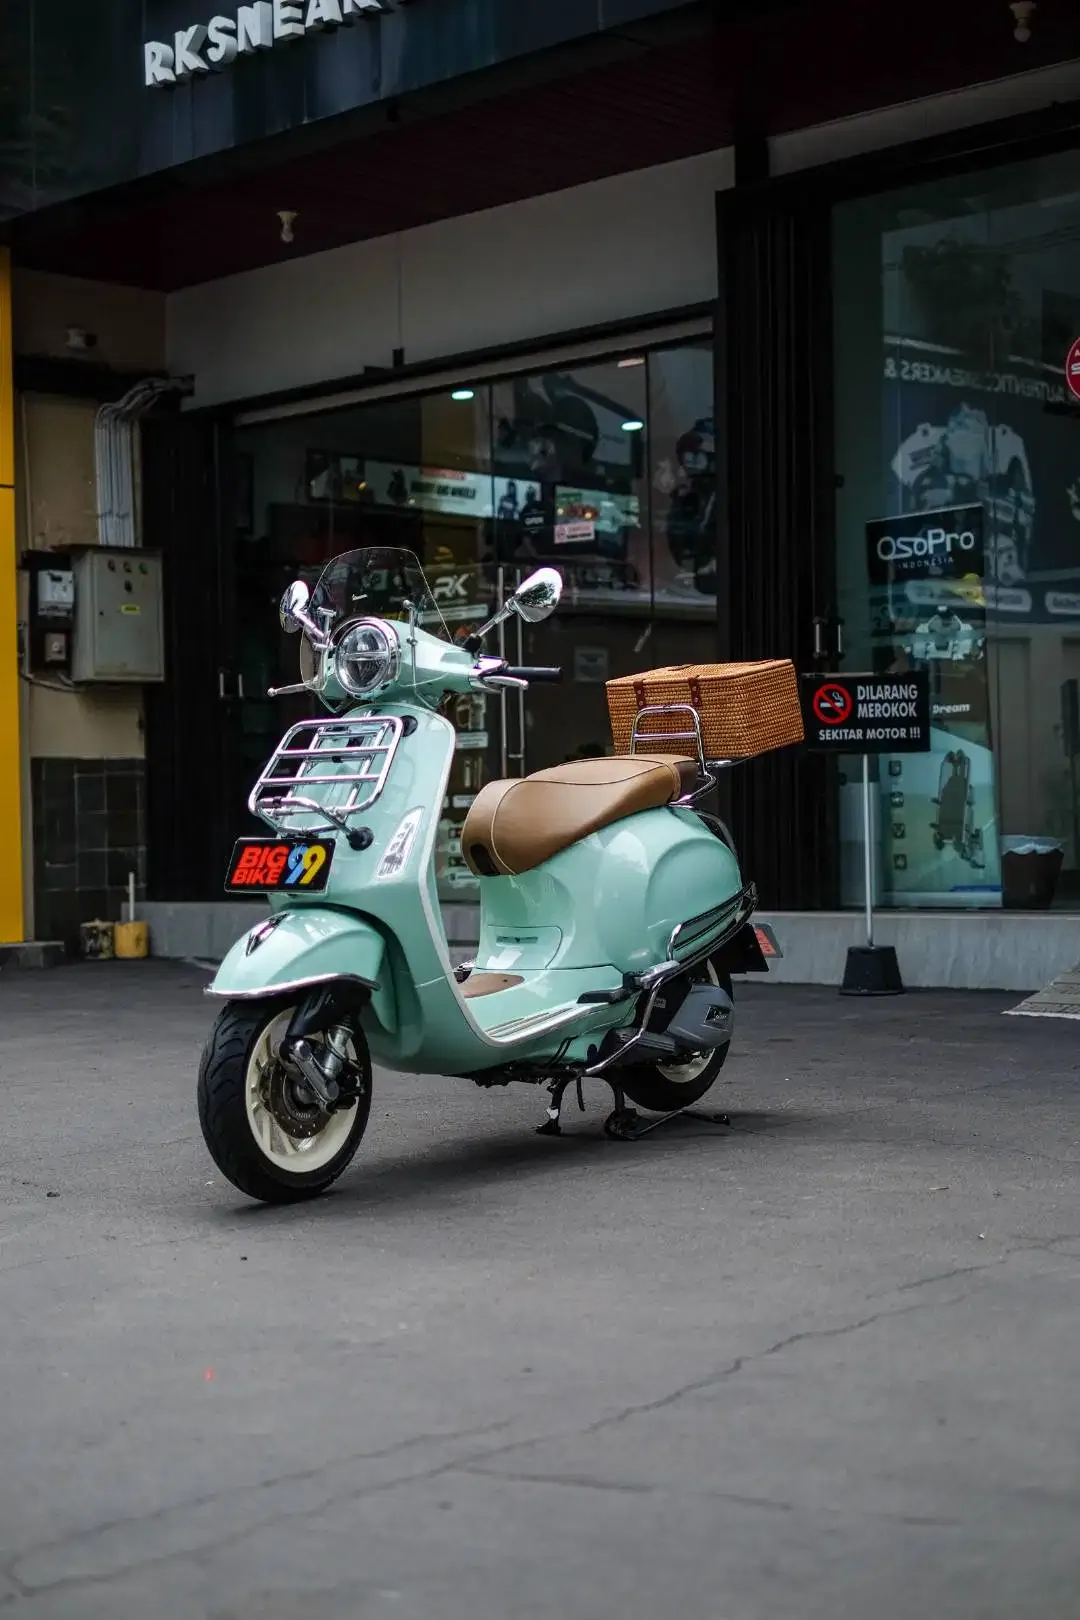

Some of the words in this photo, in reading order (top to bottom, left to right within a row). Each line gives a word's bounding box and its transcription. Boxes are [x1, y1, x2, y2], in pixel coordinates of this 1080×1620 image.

[143, 0, 383, 88] RKSNEA
[897, 556, 954, 569] INDONESIA
[857, 684, 919, 701] DILARANG
[857, 701, 918, 719] MEROKOK
[818, 727, 864, 741] SEKITAR
[866, 726, 907, 740] MOTOR
[909, 725, 921, 739] !!!
[237, 844, 290, 869] BIG
[284, 843, 327, 885] 99
[230, 868, 282, 885] BIKE
